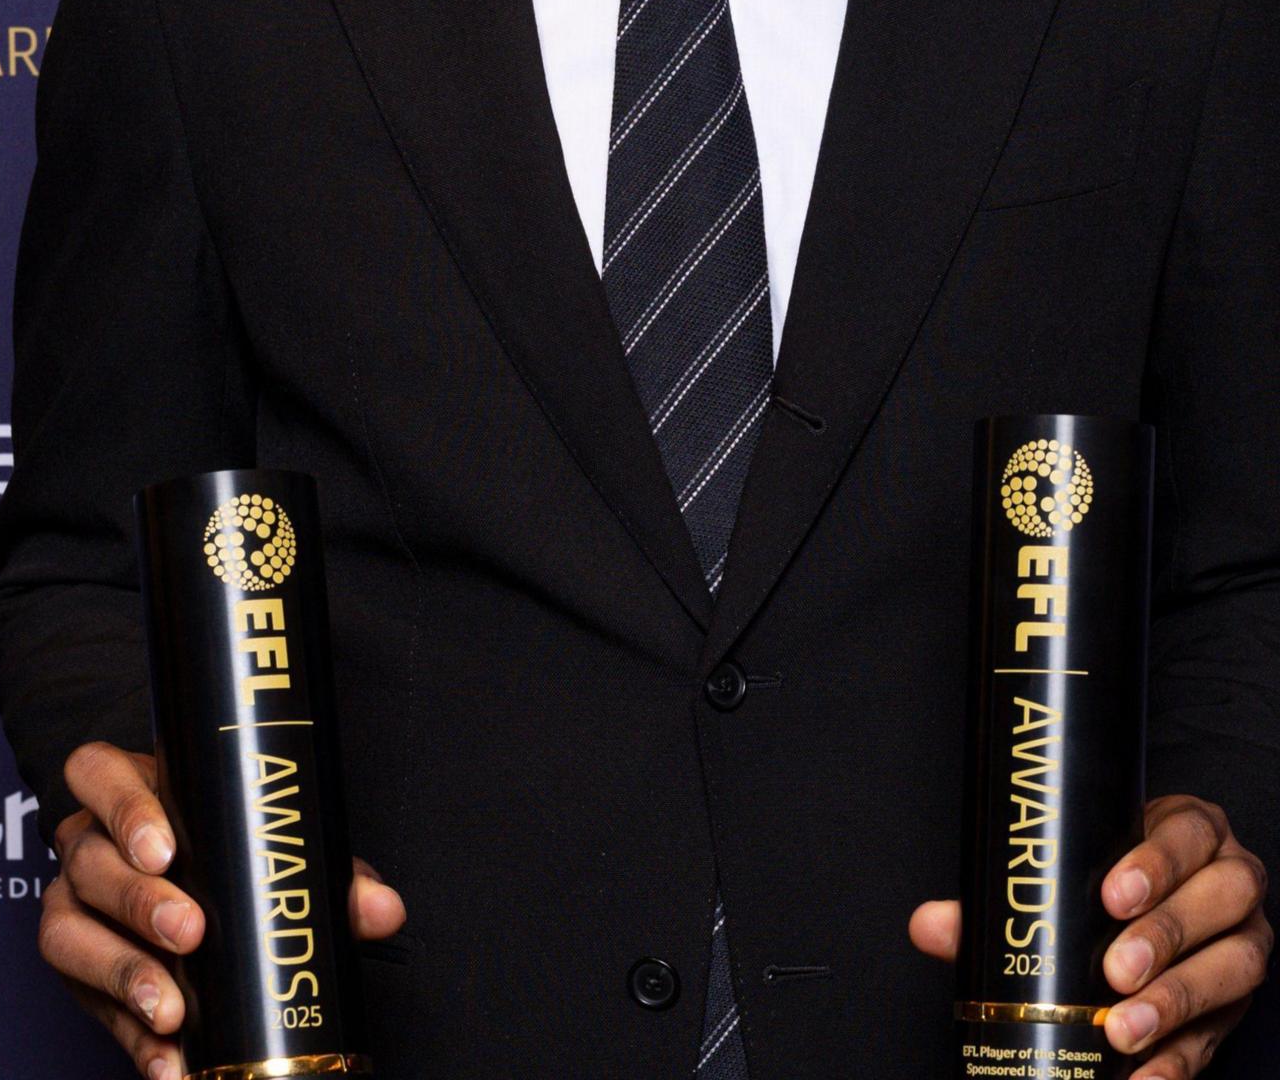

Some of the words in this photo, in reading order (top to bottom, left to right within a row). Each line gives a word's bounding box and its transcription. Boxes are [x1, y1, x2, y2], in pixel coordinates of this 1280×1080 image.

[1015, 544, 1069, 653] EFL
[231, 597, 292, 708] EFL
[1006, 695, 1066, 949] AWARDS
[245, 752, 321, 1003] AWARDS
[1003, 954, 1056, 976] 2025
[272, 1005, 323, 1030] 2025
[962, 1045, 978, 1057] EFL
[980, 1046, 1016, 1060] Player
[1018, 1048, 1033, 1059] of
[1034, 1048, 1055, 1060] the
[1058, 1049, 1102, 1062] Season
[966, 1063, 1025, 1077] Sponsored
[1028, 1065, 1045, 1080] by
[1047, 1066, 1071, 1080] Sky
[1074, 1068, 1095, 1079] Bet
